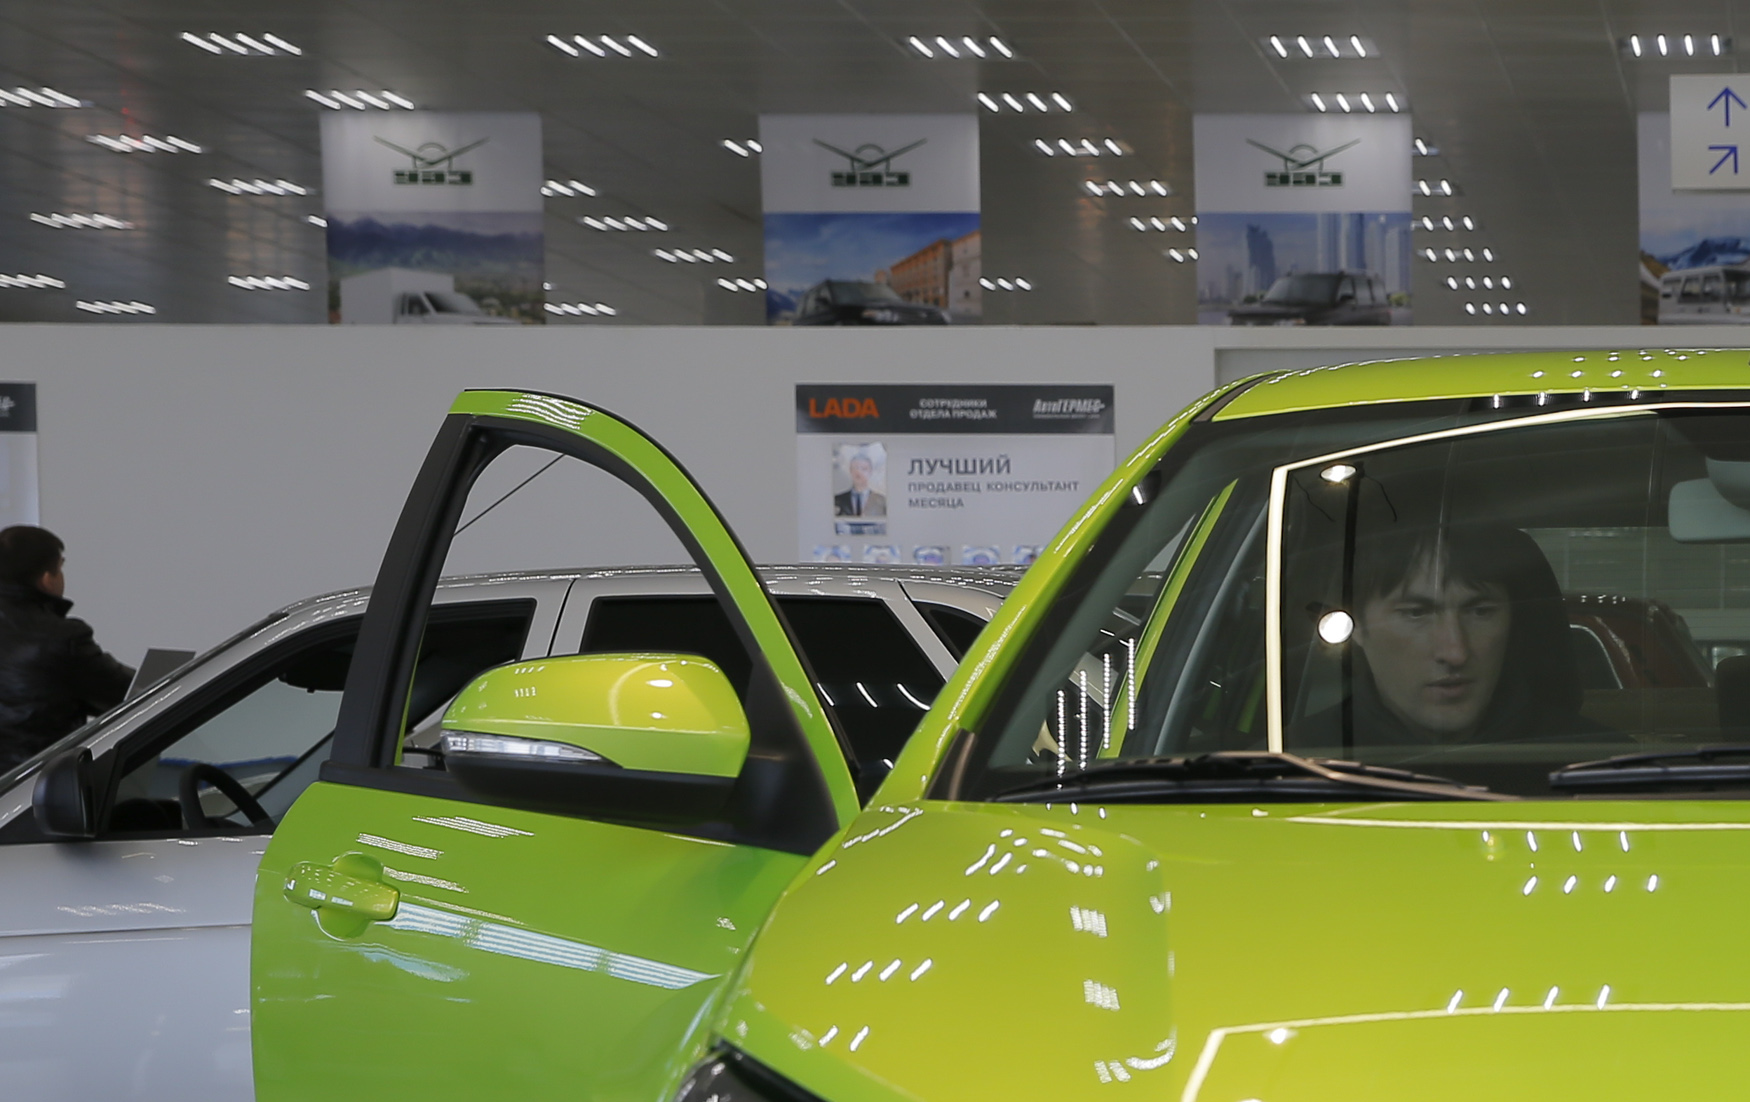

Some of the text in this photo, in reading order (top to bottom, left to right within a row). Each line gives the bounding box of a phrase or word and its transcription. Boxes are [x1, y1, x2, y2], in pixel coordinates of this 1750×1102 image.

[808, 397, 880, 419] LADA
[909, 408, 998, 420] ОТДЕЛА ПРОДАЖ
[907, 453, 1011, 476] ЛУЧШИЙ
[907, 480, 1079, 494] ПРОДАВЕЦ КОНСУЛЬТАНТ
[907, 496, 965, 510] МЕСЯЦА
